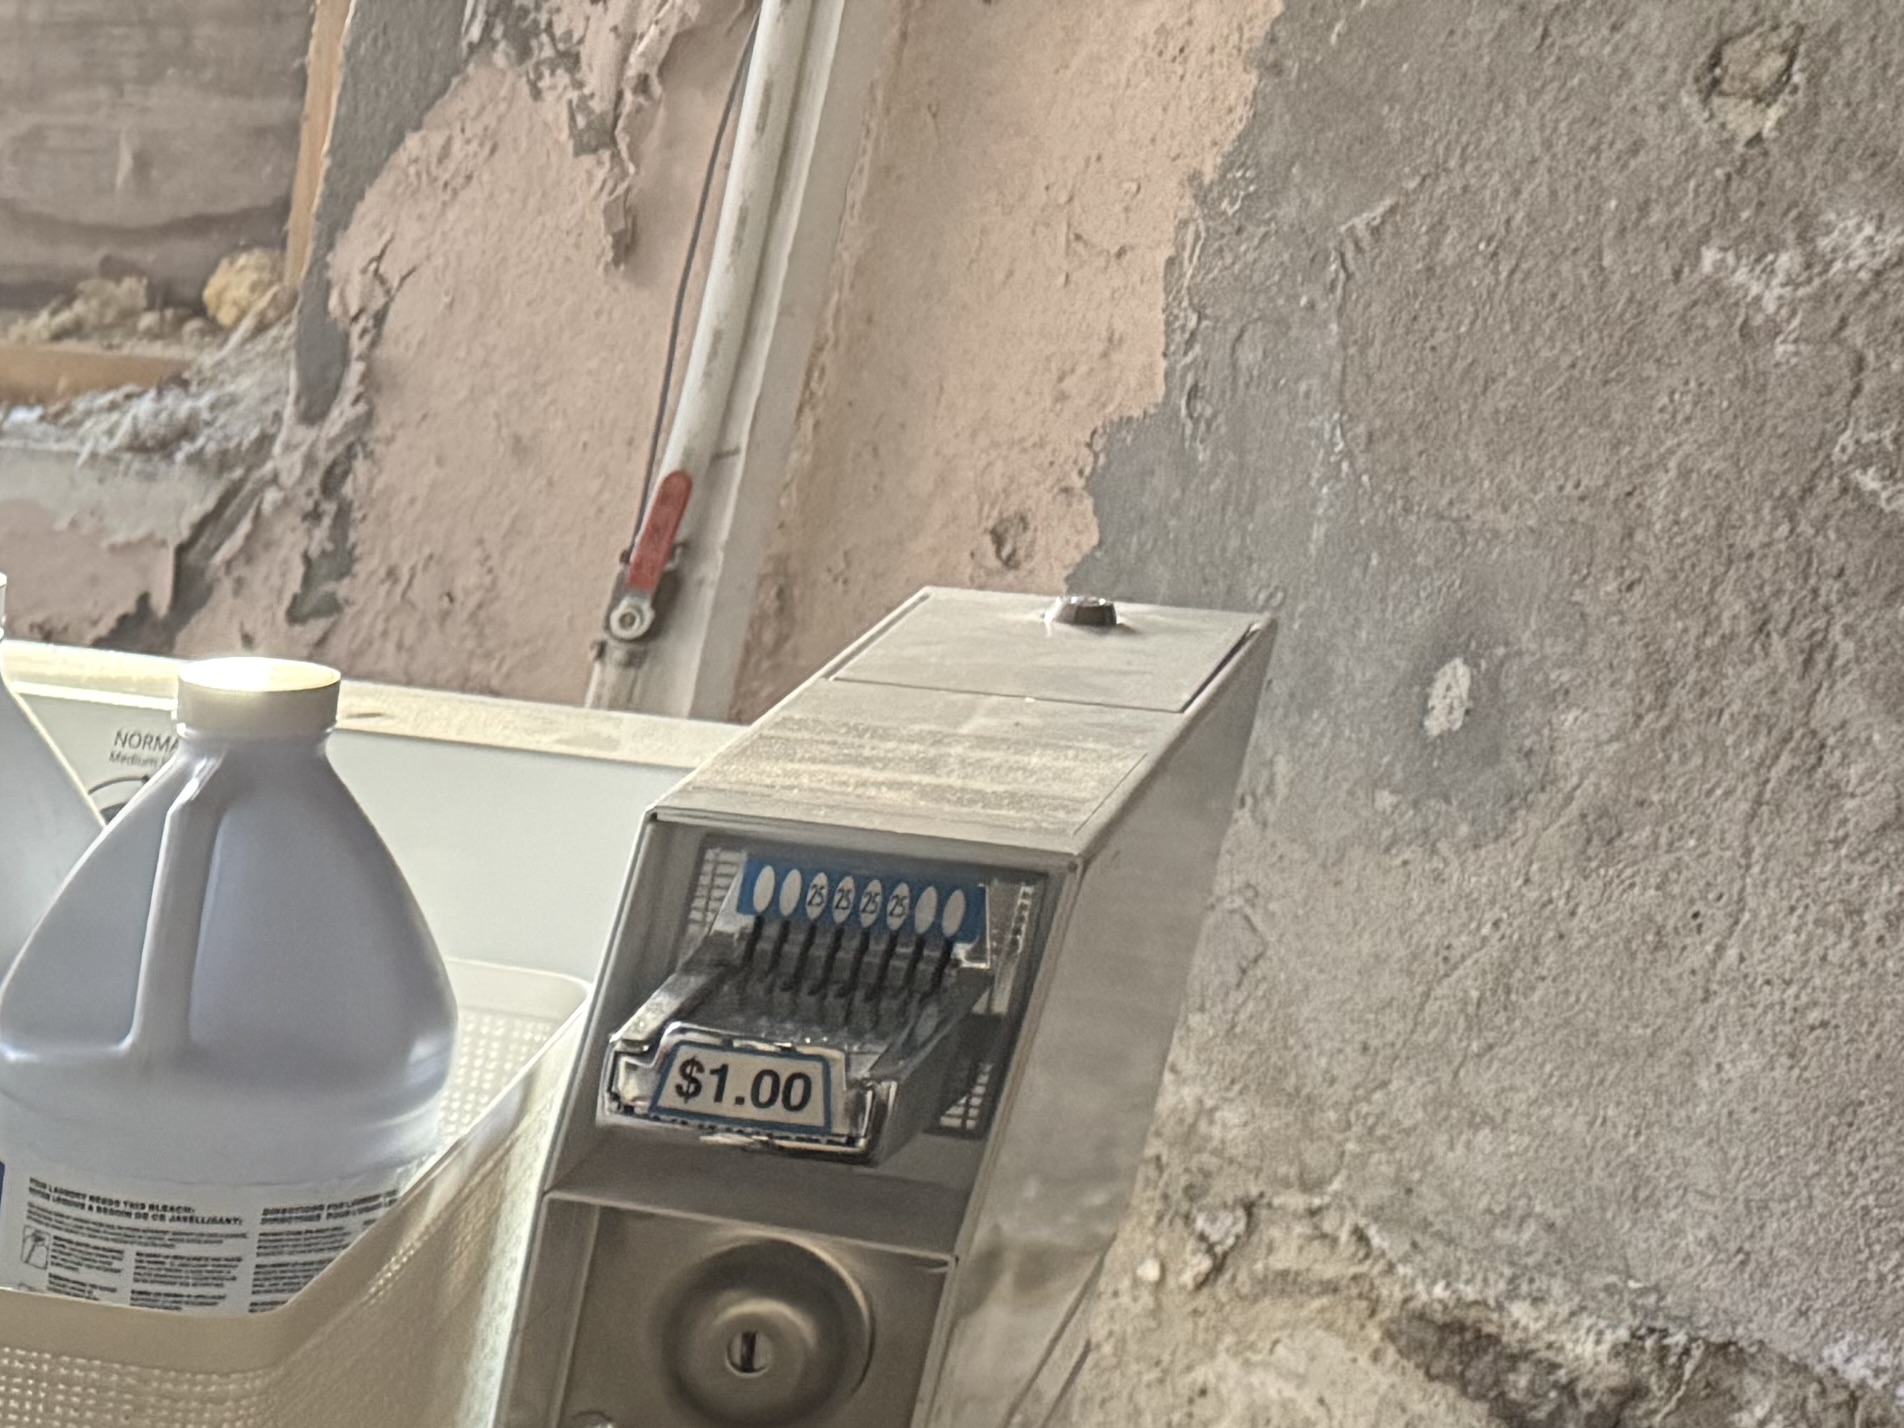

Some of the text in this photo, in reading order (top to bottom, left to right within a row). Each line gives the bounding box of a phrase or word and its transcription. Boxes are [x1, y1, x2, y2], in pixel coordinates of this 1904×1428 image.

[807, 884, 908, 918] 25 25 25 25
[674, 1055, 813, 1112] $1.00
